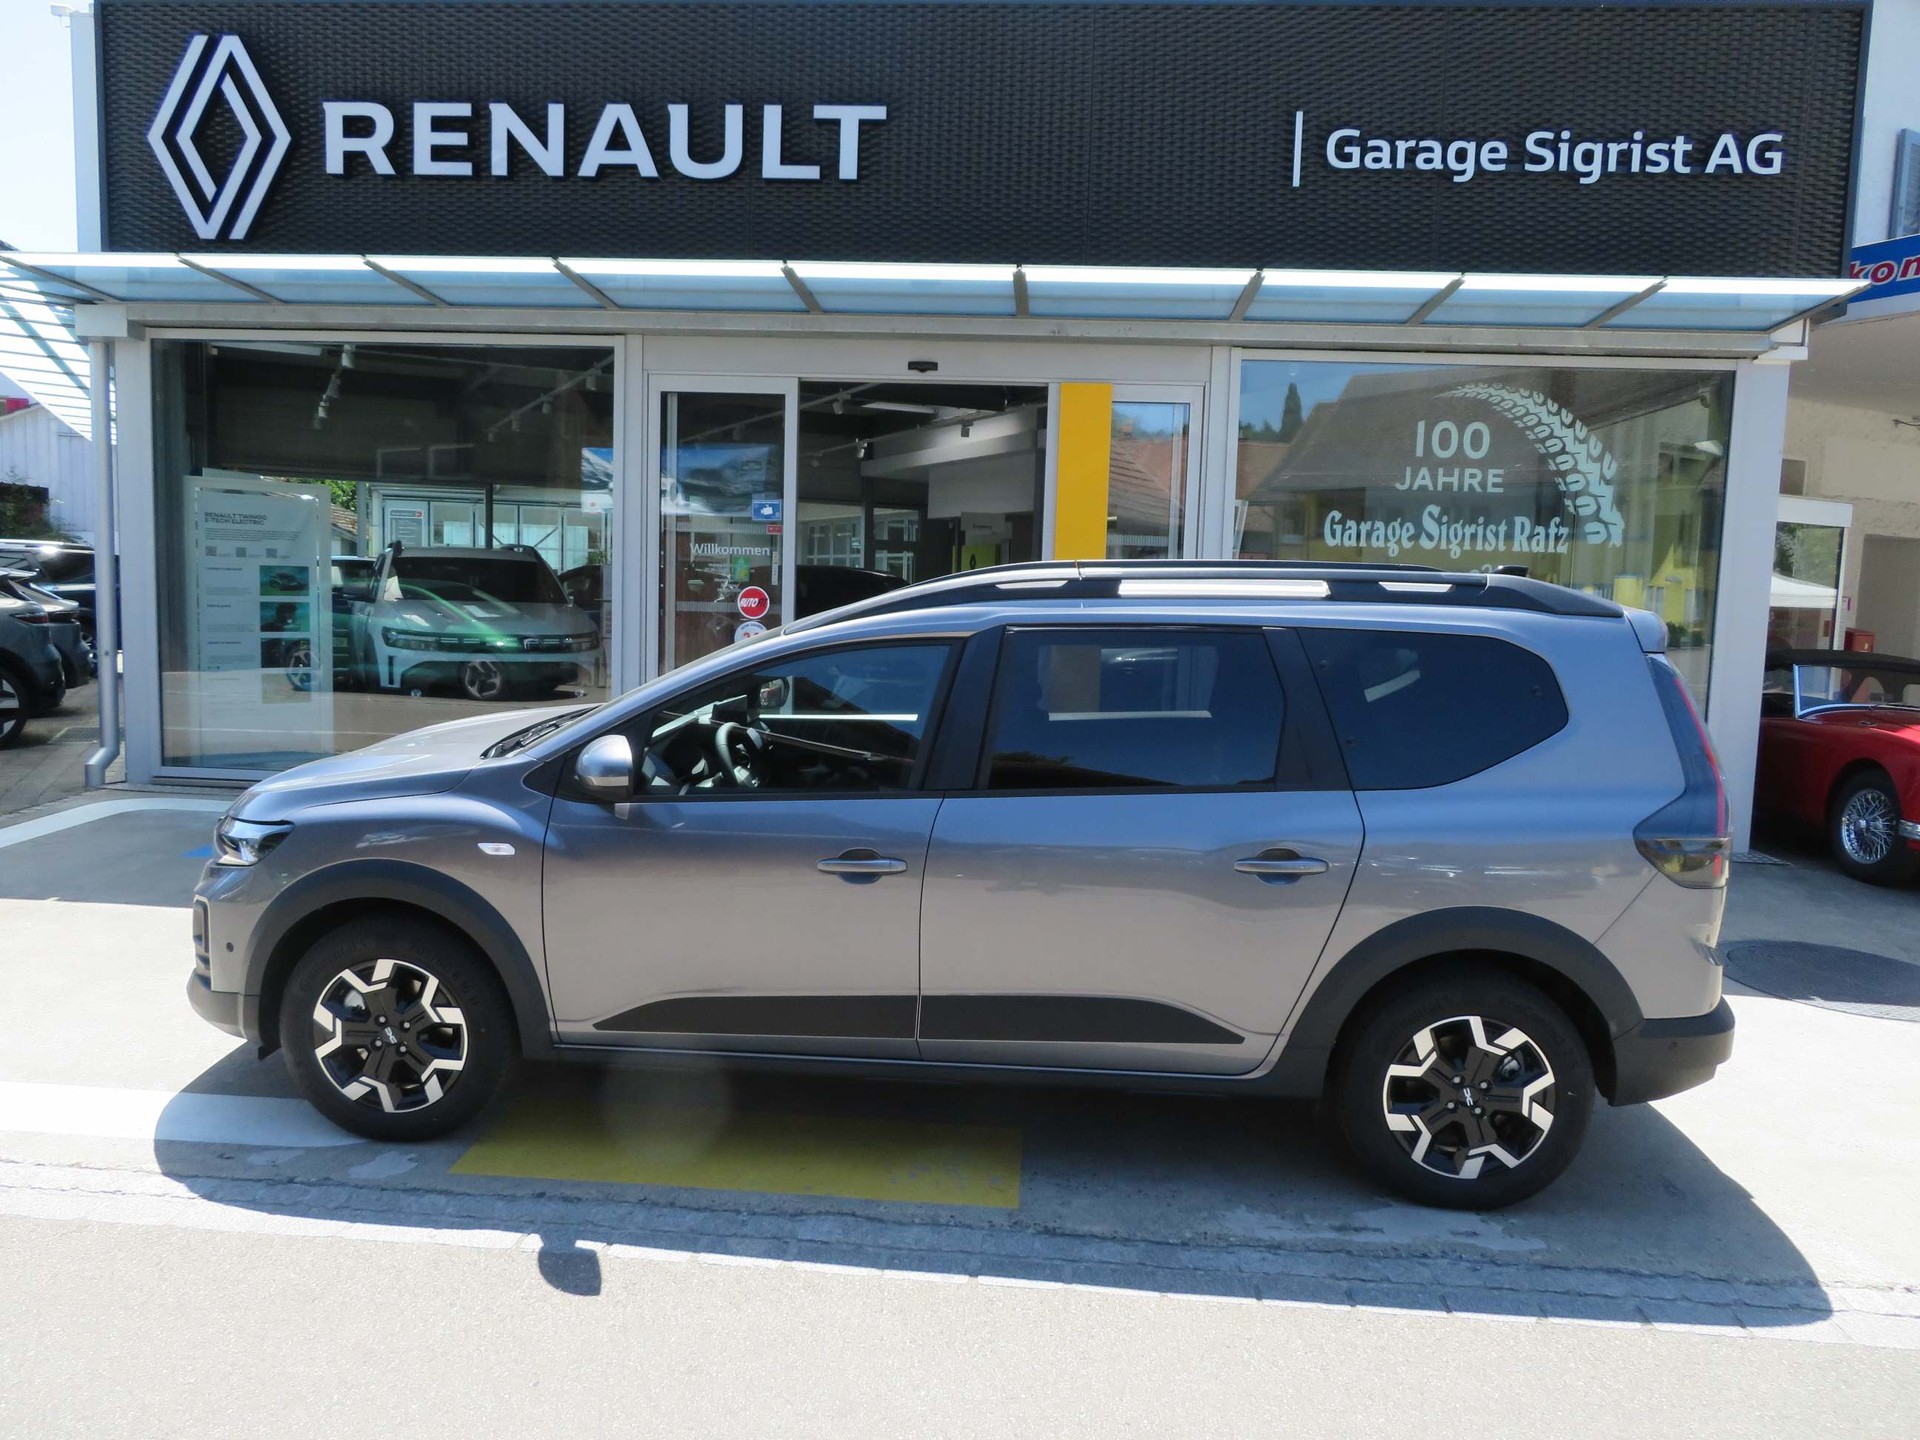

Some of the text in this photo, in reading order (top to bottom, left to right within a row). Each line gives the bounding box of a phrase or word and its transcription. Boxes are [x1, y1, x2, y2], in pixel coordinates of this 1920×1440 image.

[322, 101, 887, 180] RENAULT
[1326, 128, 1784, 184] Garage Sigrist AG
[1415, 420, 1490, 459] 100
[1395, 466, 1504, 493] JAHRE
[690, 543, 770, 556] Willkommen
[1324, 504, 1569, 559] Garage Sigrist Rafz
